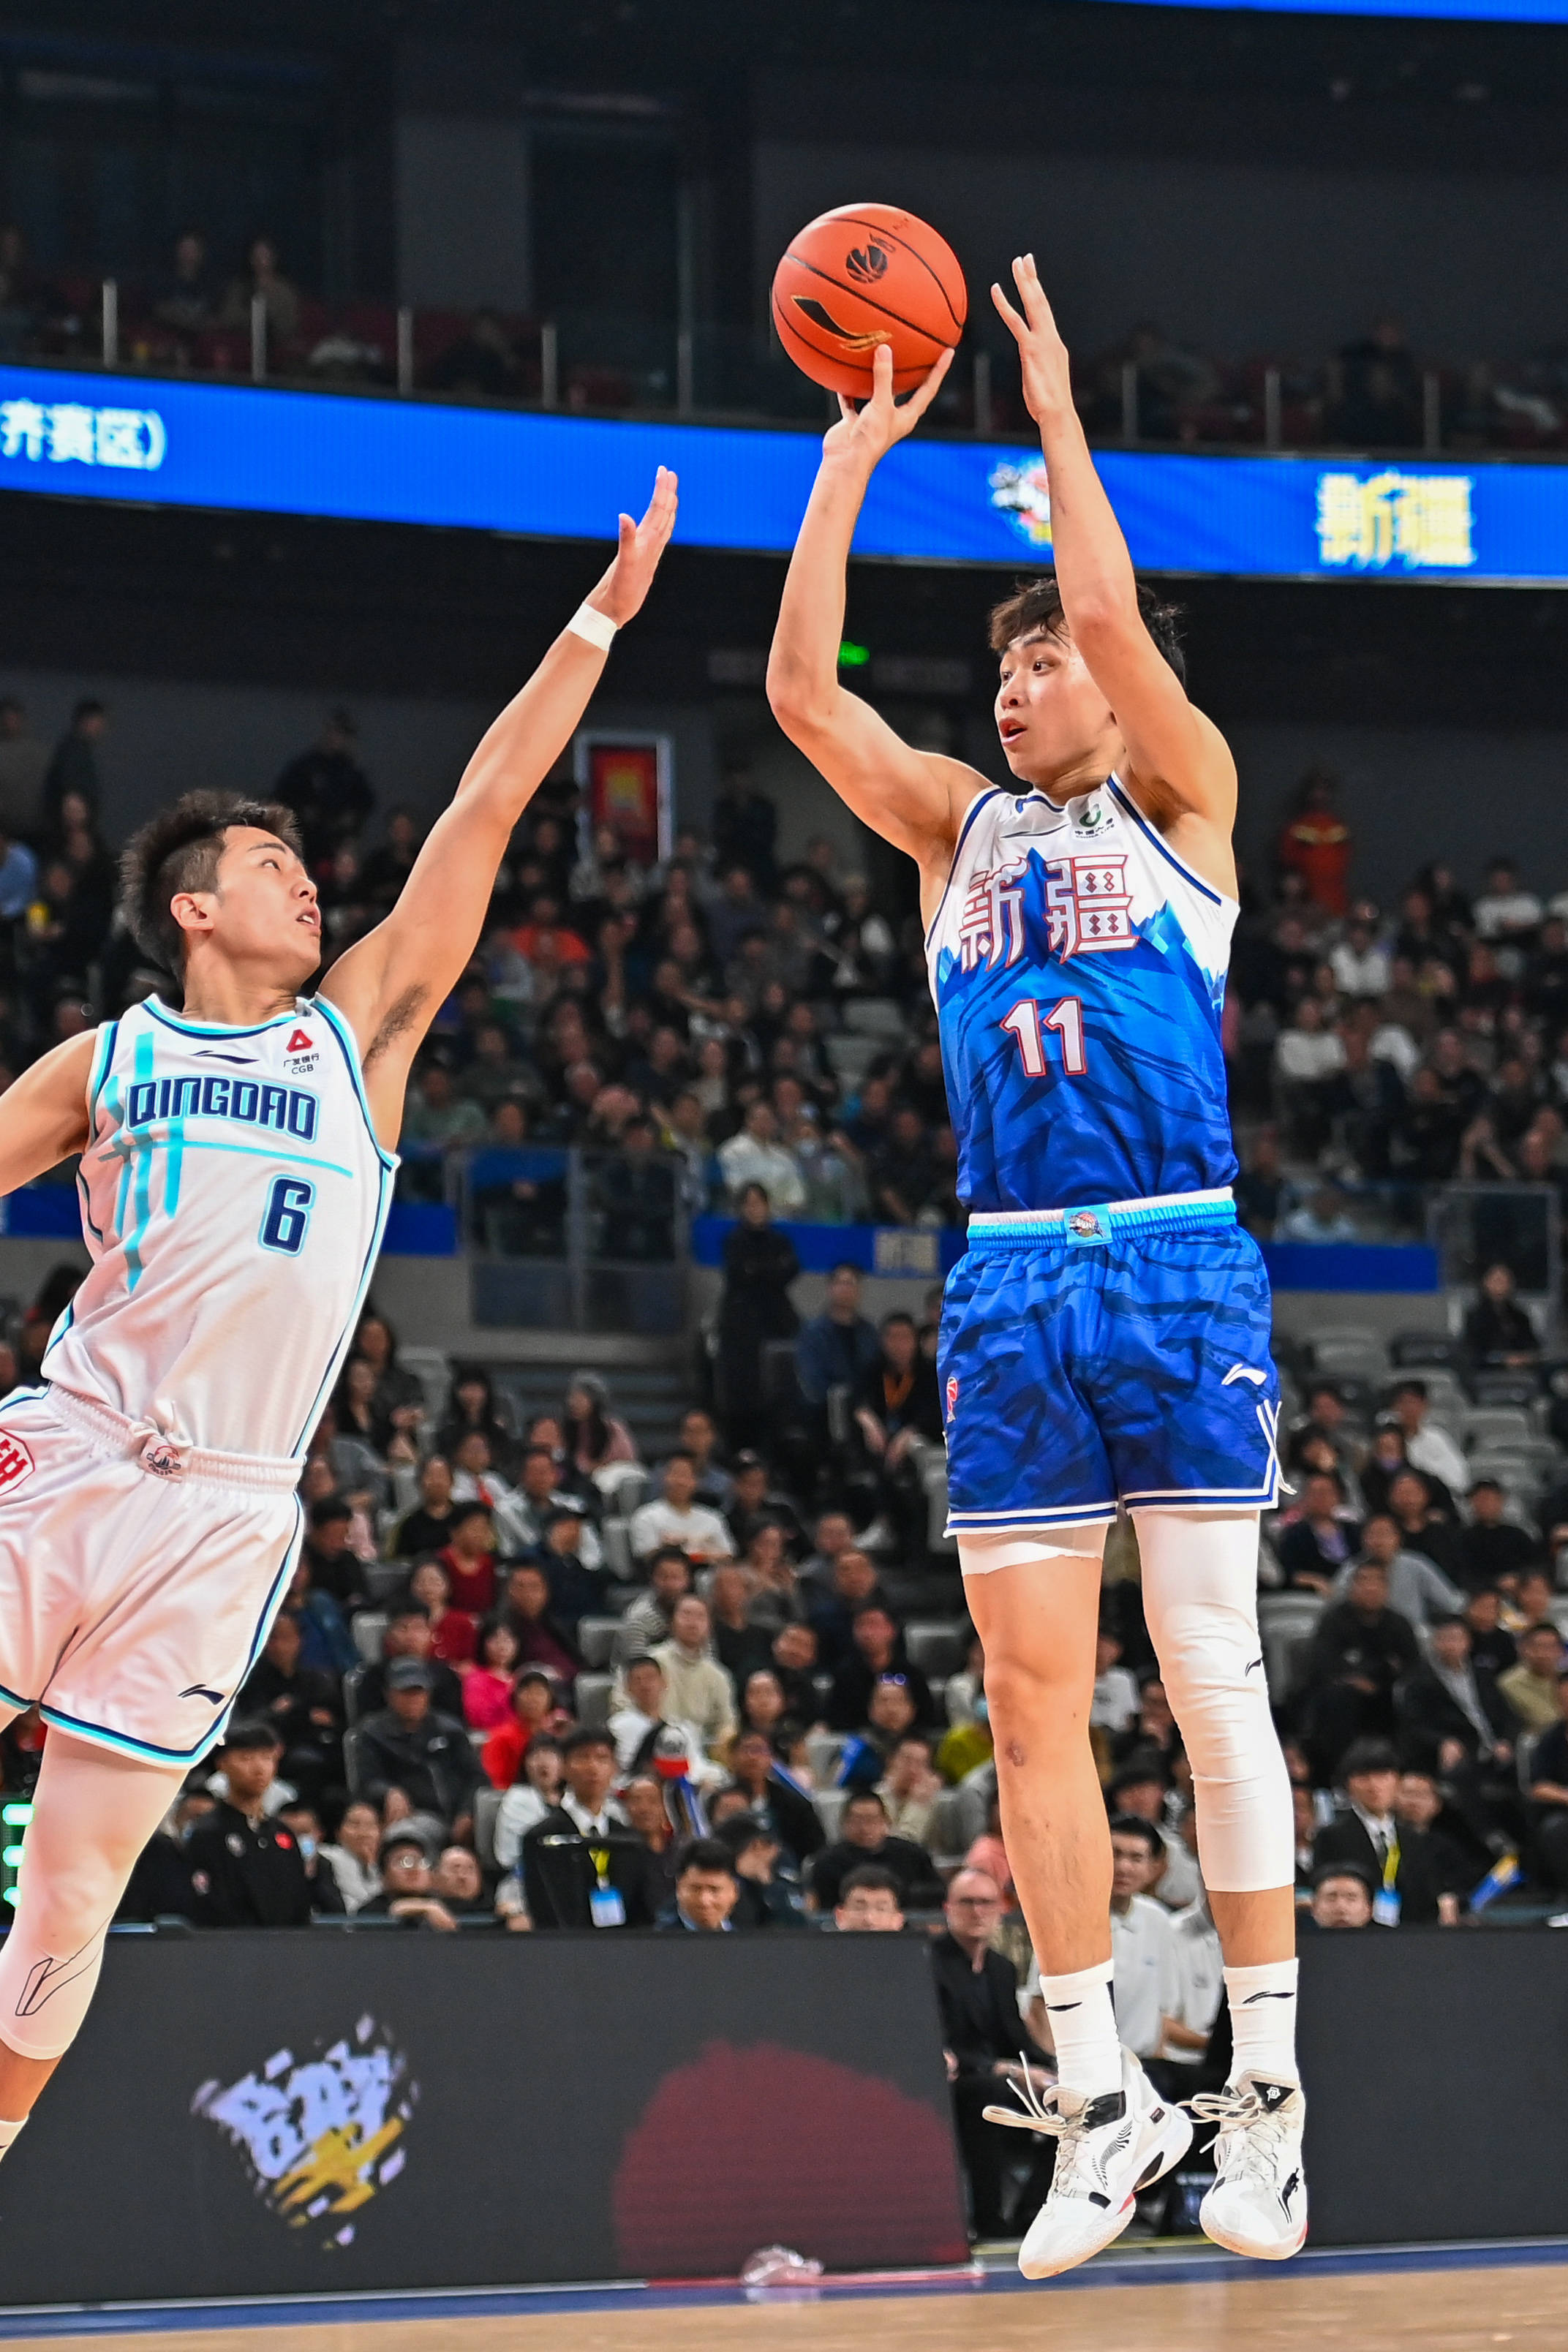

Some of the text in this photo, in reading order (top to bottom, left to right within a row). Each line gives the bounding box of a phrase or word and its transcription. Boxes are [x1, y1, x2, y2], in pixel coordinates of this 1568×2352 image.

[959, 854, 1140, 973] 新疆
[291, 1063, 314, 1074] CGB
[999, 996, 1088, 1077] 11
[127, 1077, 319, 1143] QINGDAO
[260, 1176, 314, 1255] 6
